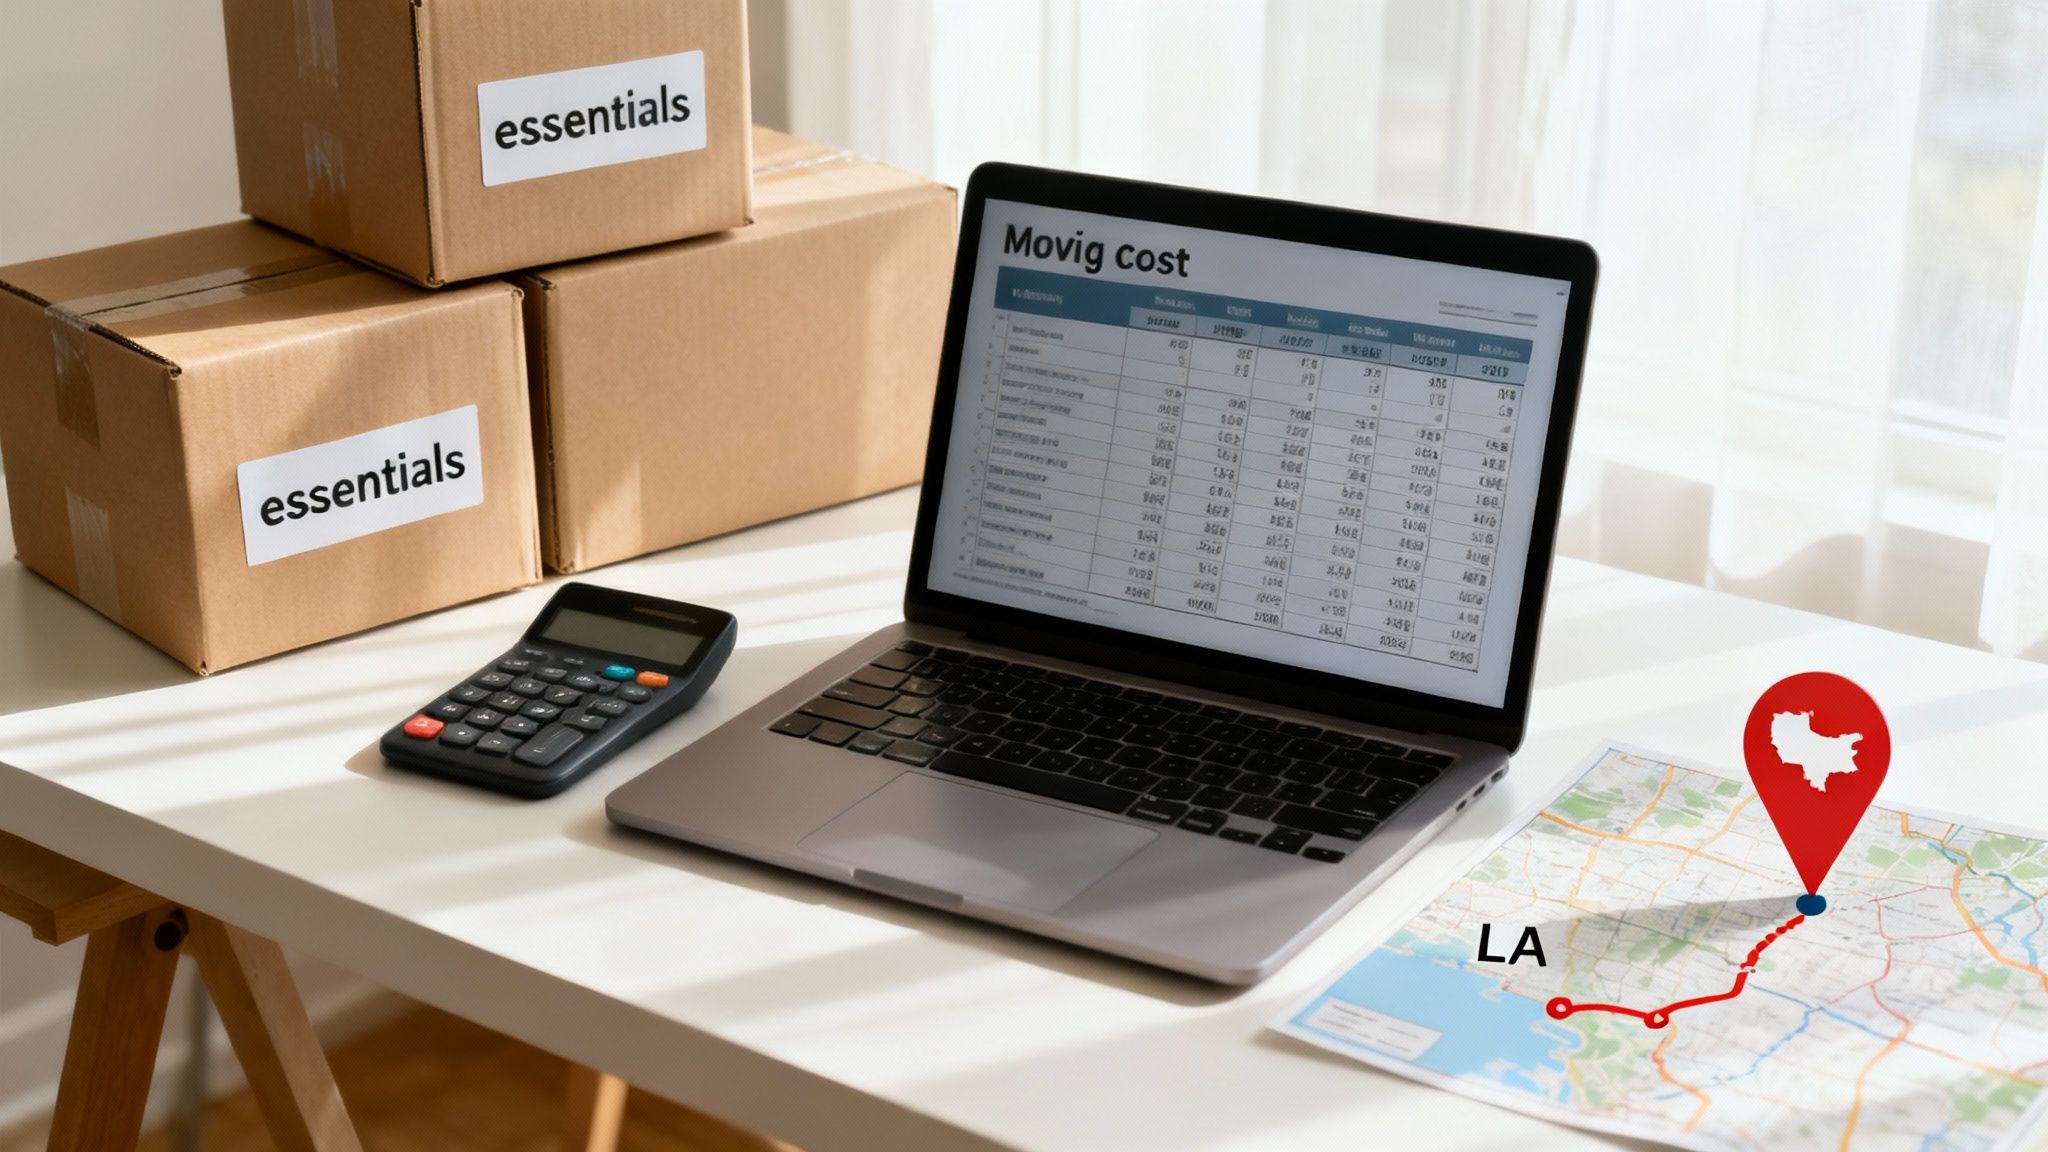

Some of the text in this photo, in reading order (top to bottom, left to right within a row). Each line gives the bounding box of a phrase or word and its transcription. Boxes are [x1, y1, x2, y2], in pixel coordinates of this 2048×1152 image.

[495, 84, 691, 150] essentials
[1003, 223, 1191, 278] Movig cost
[260, 442, 466, 527] essentials
[1477, 923, 1547, 967] LA
